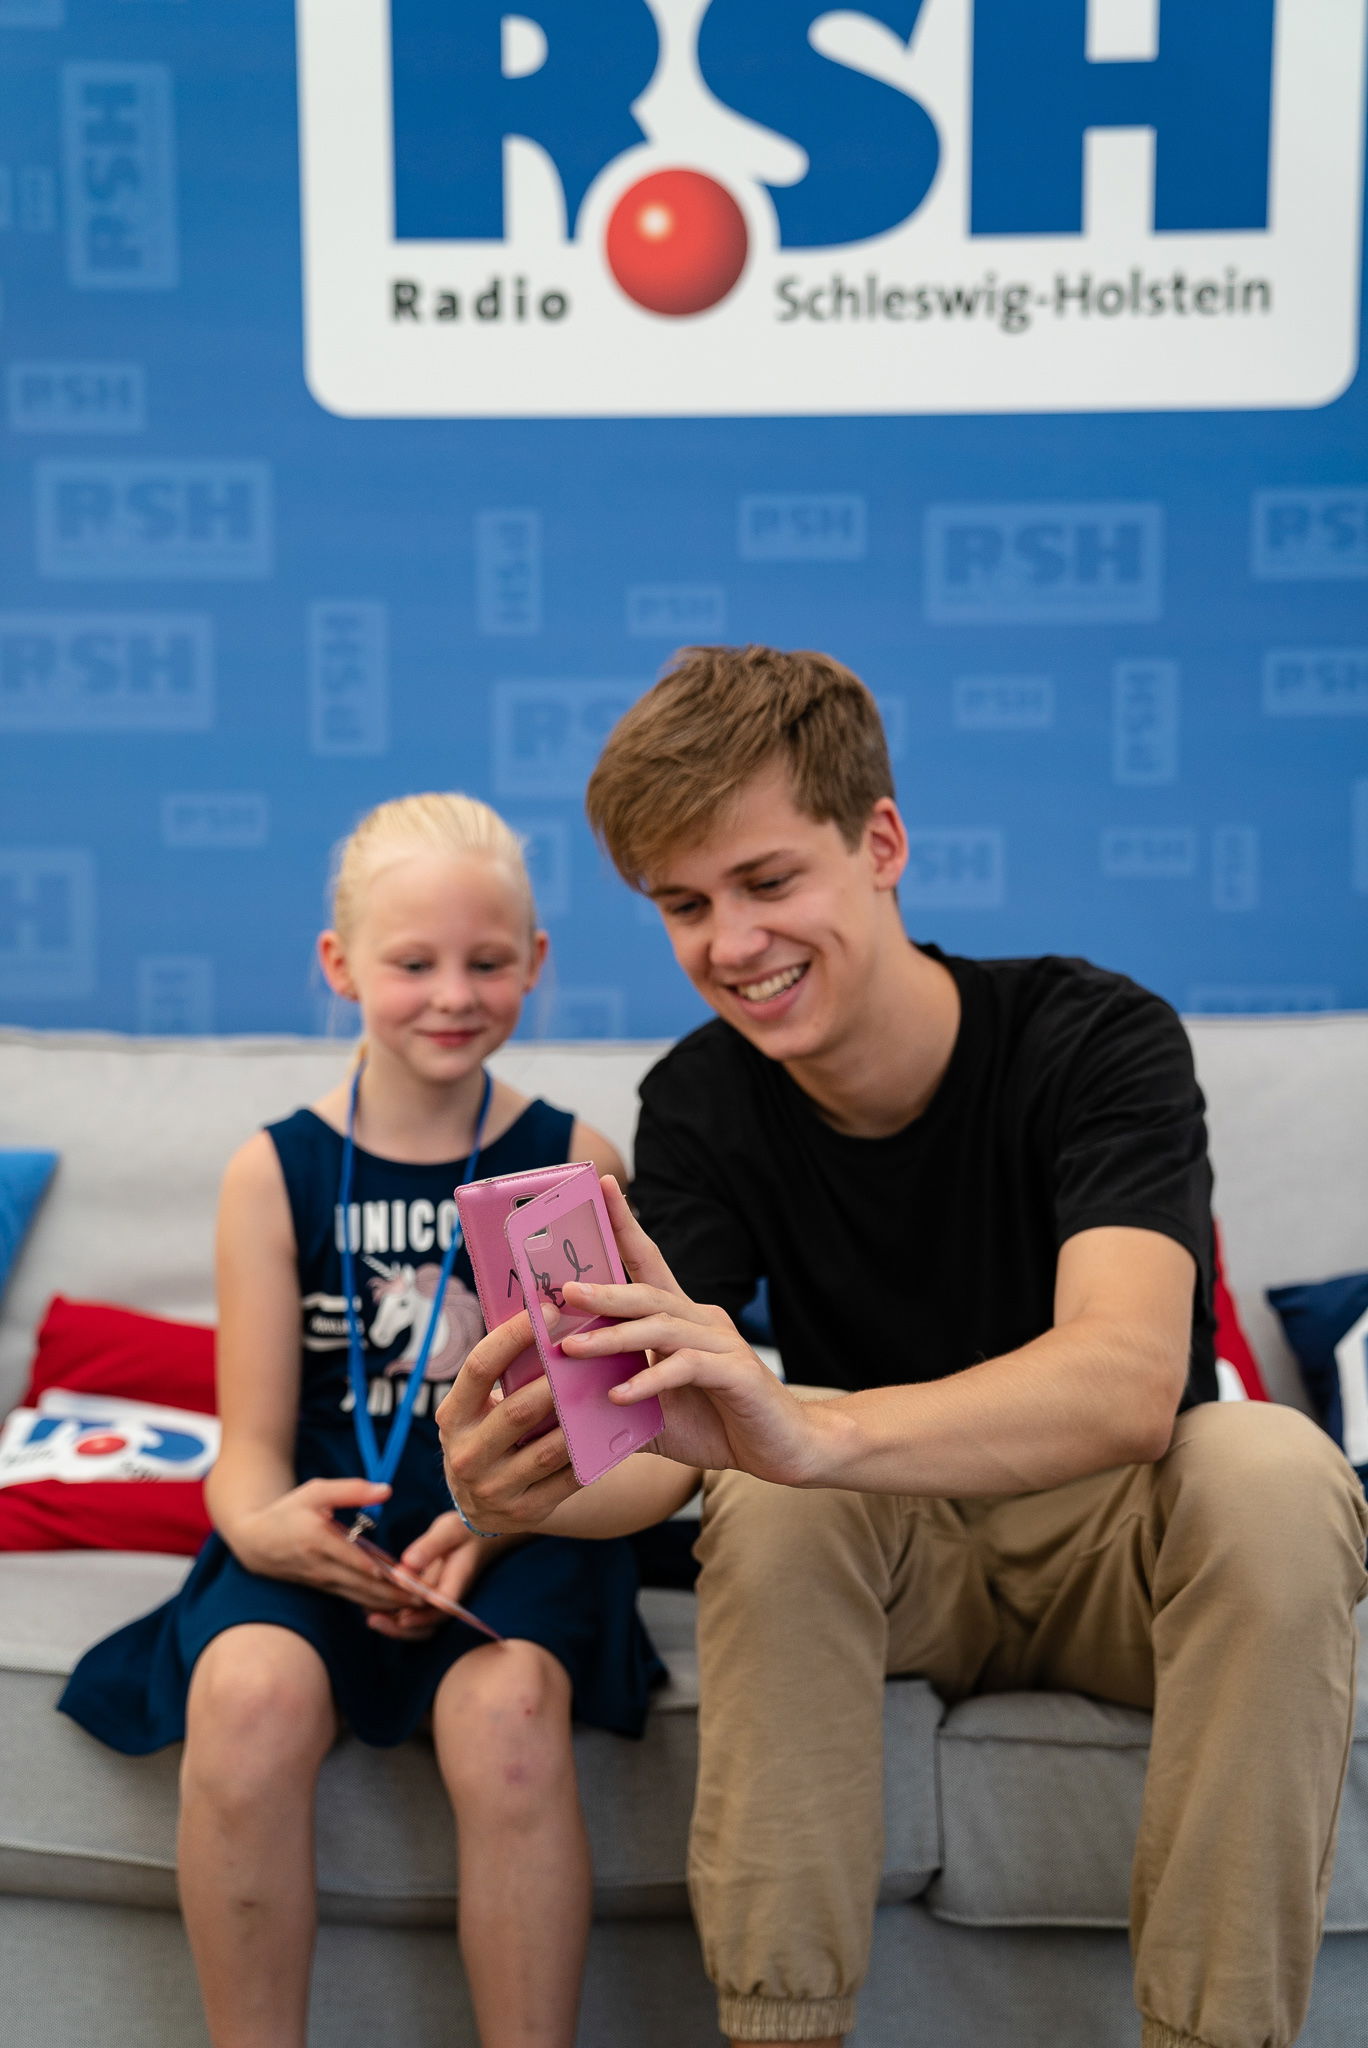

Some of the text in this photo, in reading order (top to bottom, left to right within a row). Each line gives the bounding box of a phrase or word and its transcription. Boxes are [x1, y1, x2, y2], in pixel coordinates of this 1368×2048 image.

[390, 0, 1274, 252] RSH
[390, 268, 1274, 334] Radio Schleswig-Holstein
[56, 480, 254, 542] RSH
[1267, 503, 1368, 551] RS
[943, 524, 1145, 584] RSH
[0, 632, 195, 695] RSH
[909, 840, 993, 885] SH
